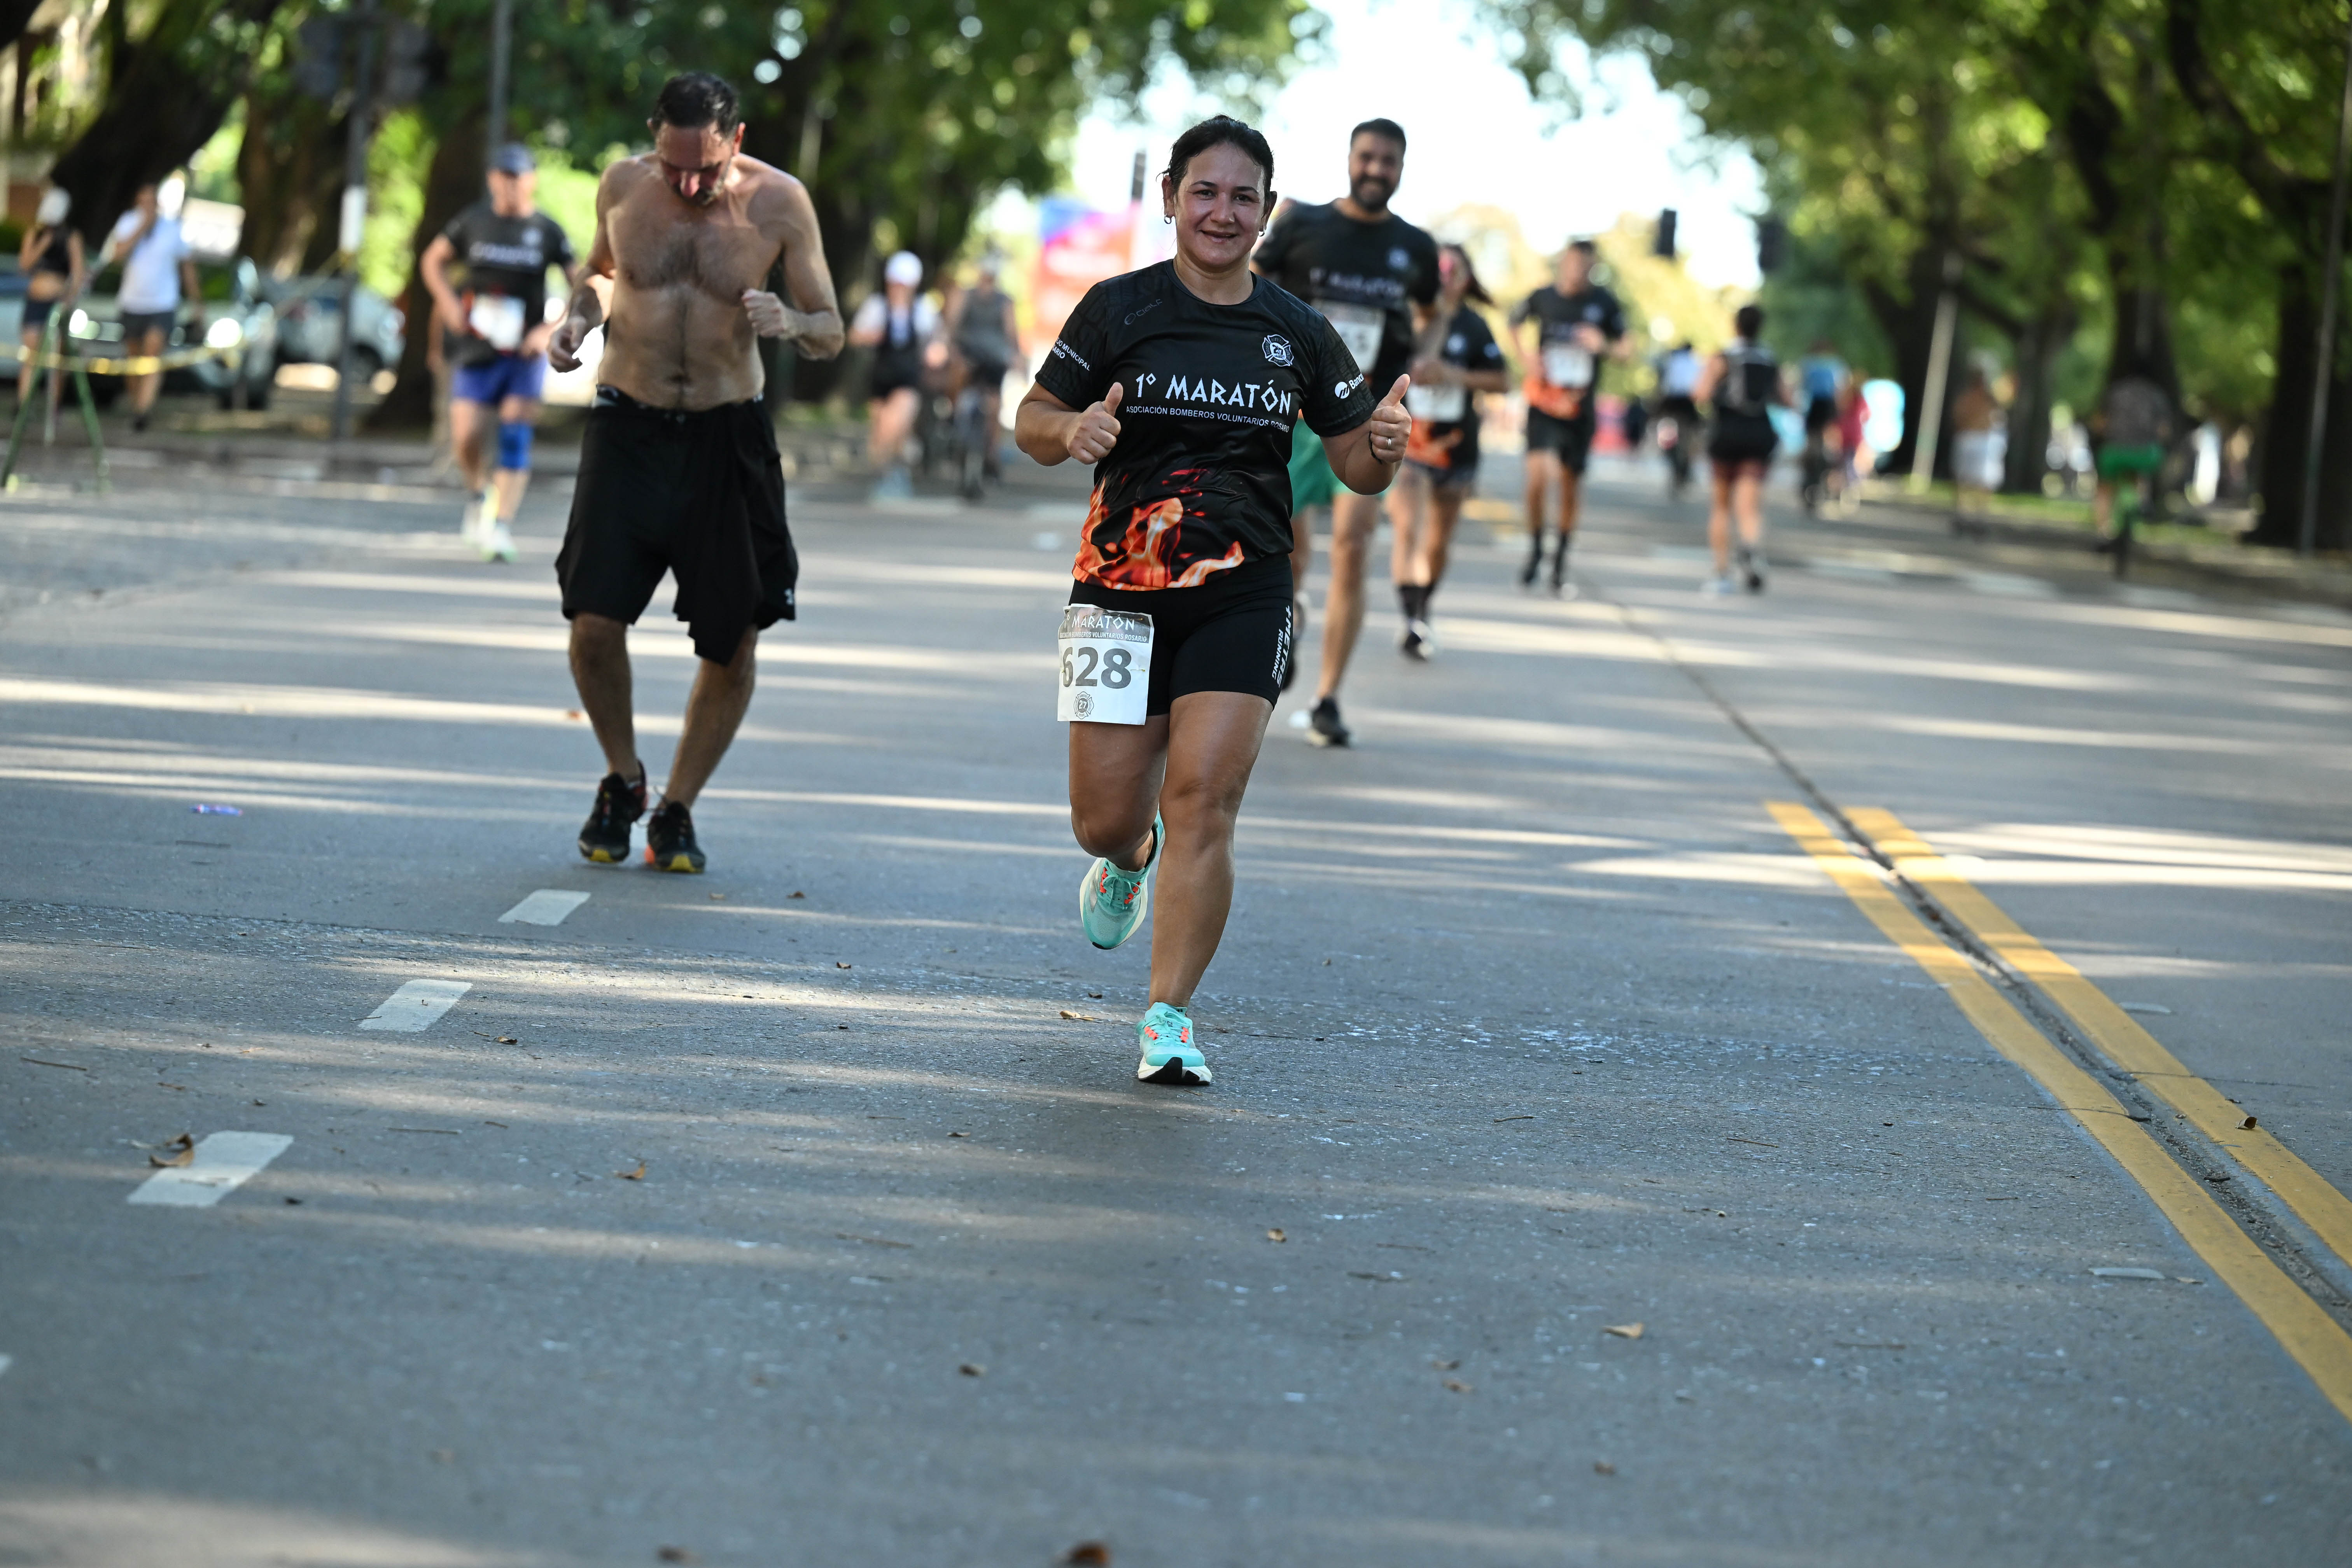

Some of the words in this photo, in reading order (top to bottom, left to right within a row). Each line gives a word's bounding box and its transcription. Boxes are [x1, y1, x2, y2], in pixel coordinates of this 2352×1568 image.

[1062, 343, 1090, 371] MUNICIPAL
[1165, 374, 1291, 416] MARATÓN
[1126, 405, 1167, 415] ASOCIACIÓN
[1170, 408, 1214, 419] BOMBEROS
[1217, 413, 1269, 426] VOLUNTARIOS
[1270, 420, 1290, 433] ROSARIO
[1072, 614, 1135, 631] MARATÓN
[1092, 632, 1124, 640] VOLUNTARIOS
[1125, 634, 1147, 642] ROSARIO
[1063, 646, 1132, 689] 628
[1272, 628, 1284, 680] RUNNING
[1078, 699, 1088, 710] 27
